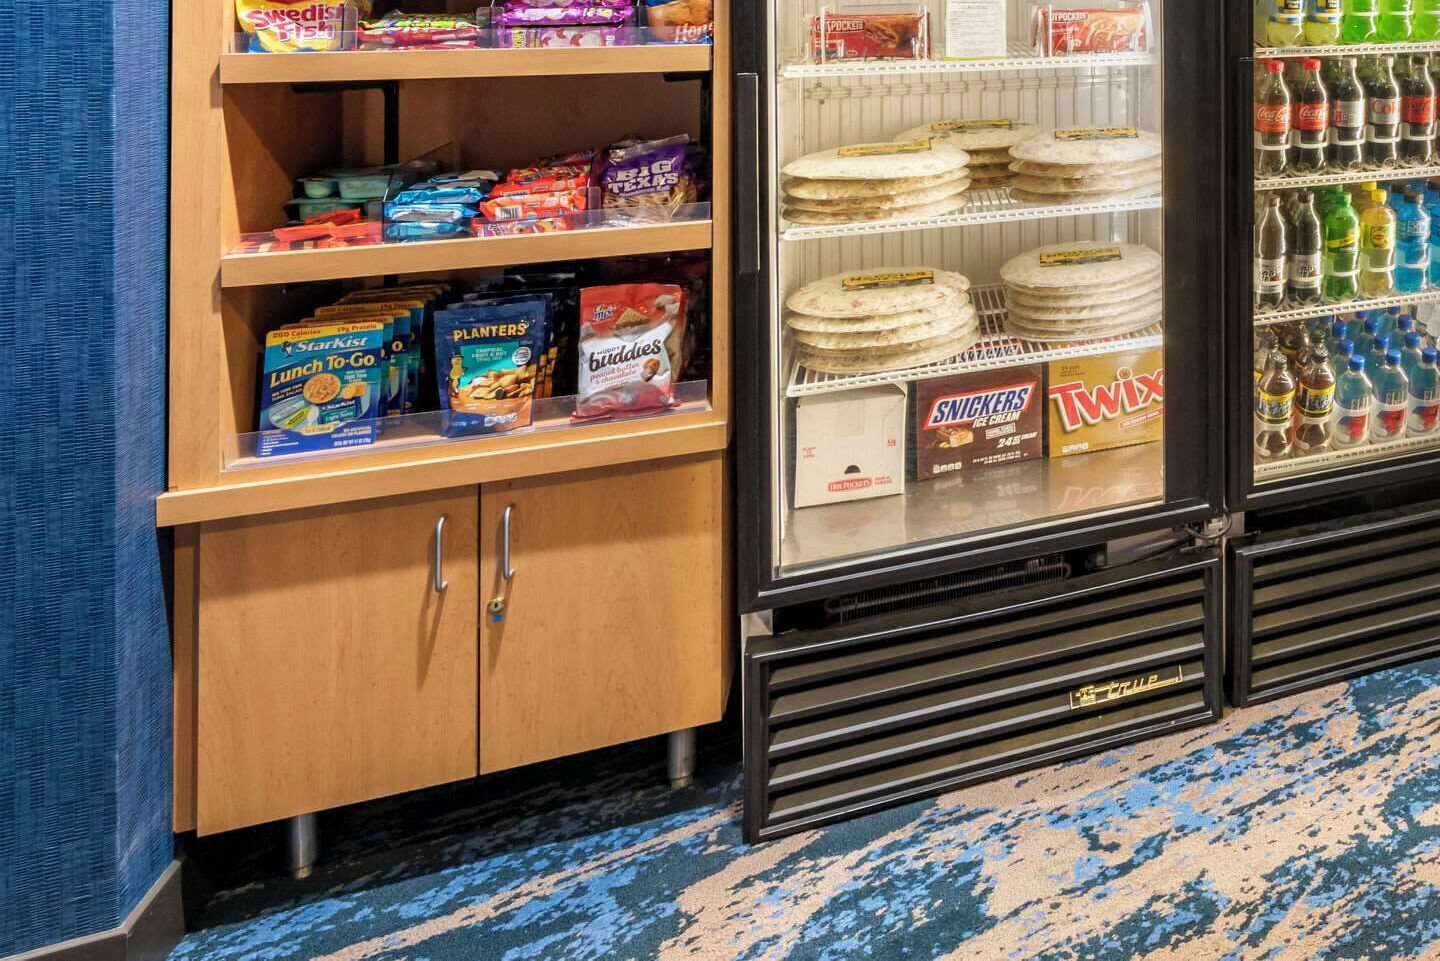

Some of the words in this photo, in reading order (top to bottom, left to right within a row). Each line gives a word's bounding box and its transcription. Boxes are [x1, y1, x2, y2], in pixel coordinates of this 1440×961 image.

[274, 21, 336, 42] Fish
[673, 23, 713, 42] Hon
[617, 160, 672, 181] BIG
[608, 172, 679, 193] TEXAS
[351, 323, 377, 331] Protein
[453, 322, 528, 342] PLANTERS
[296, 336, 368, 352] StarKist
[589, 339, 662, 372] buddies
[270, 359, 324, 388] Lunch
[932, 387, 1029, 424] SNICKERS
[1049, 367, 1163, 432] Twix
[972, 416, 989, 428] ICE
[989, 411, 1021, 425] CREAM
